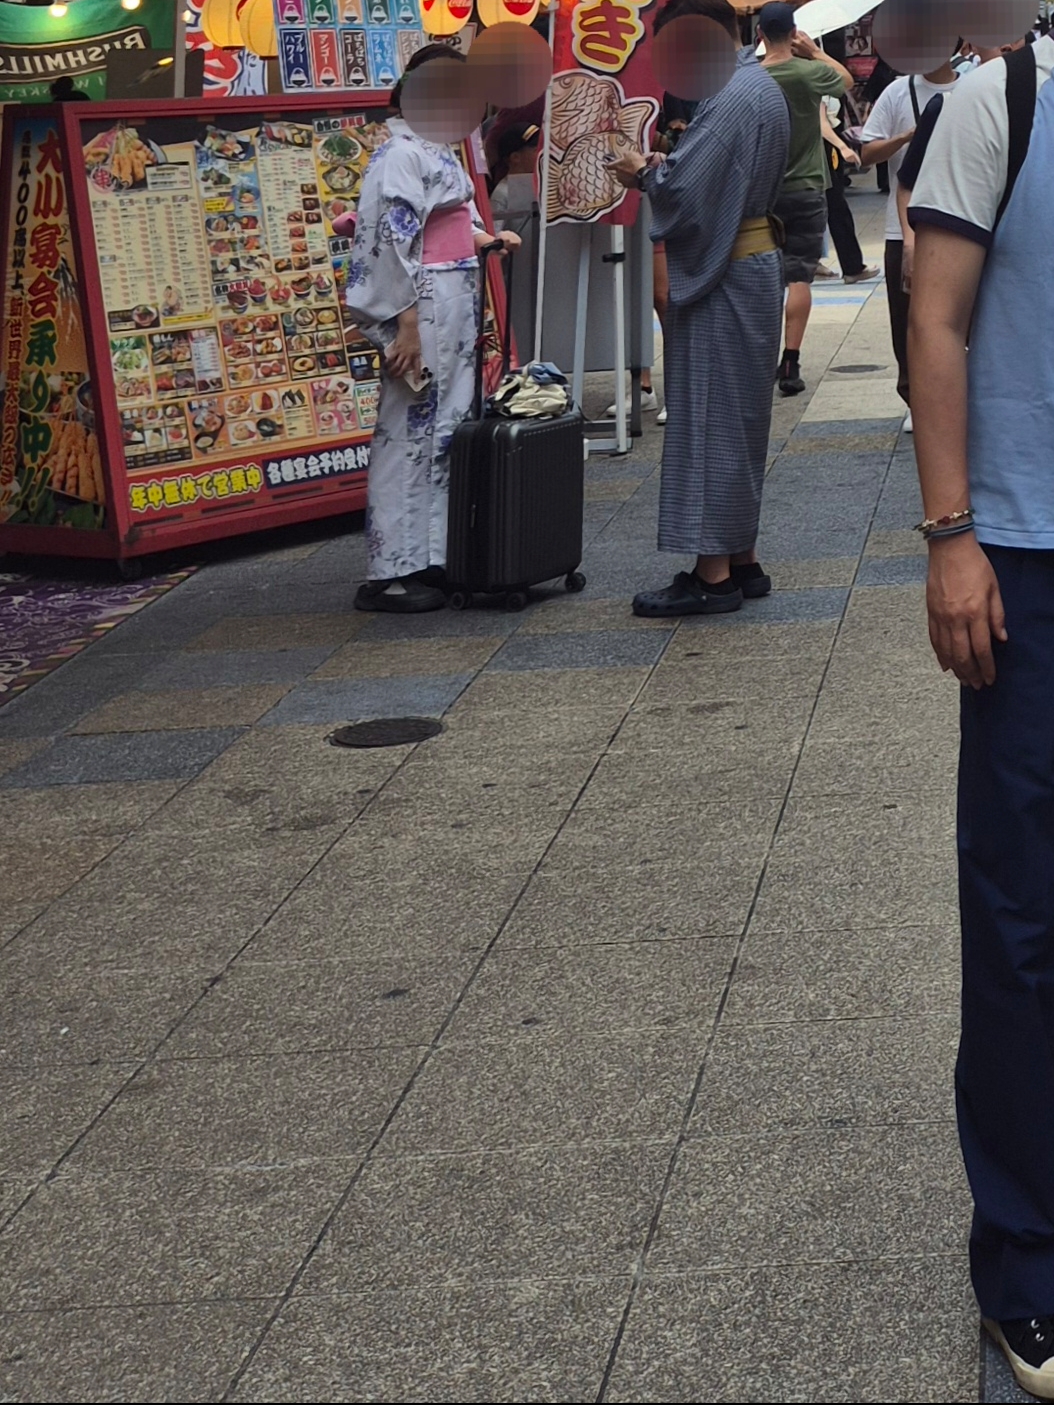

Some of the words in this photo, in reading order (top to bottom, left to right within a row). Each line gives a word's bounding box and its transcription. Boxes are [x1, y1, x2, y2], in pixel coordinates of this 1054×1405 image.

[285, 35, 298, 66] ハワイ
[321, 34, 335, 68] マンゴー
[266, 446, 371, 486] 各種宴会予約受付
[130, 464, 263, 510] 年中無休で営業中
